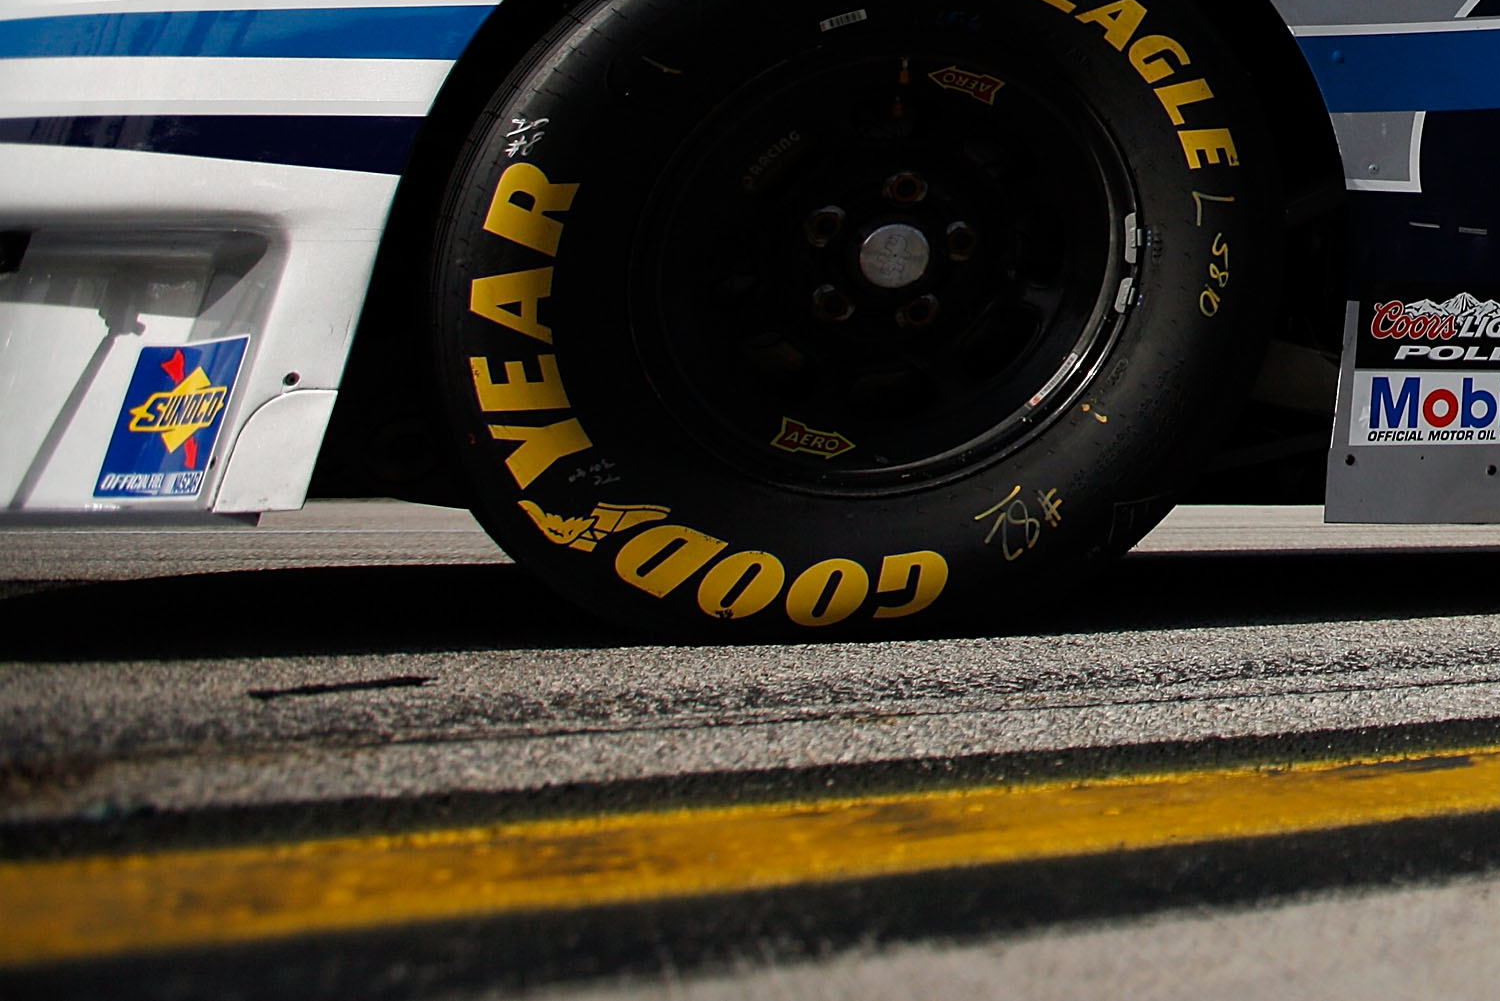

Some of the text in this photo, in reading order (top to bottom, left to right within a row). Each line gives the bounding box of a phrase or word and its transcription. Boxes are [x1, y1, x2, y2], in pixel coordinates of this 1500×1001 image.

[942, 71, 993, 95] AERO
[1370, 301, 1457, 341] Coors
[135, 390, 225, 429] SUNOCO
[785, 428, 841, 452] AERO
[1367, 430, 1424, 442] OFFICIAL
[1427, 430, 1475, 441] MOTOR
[1477, 429, 1496, 441] OIL
